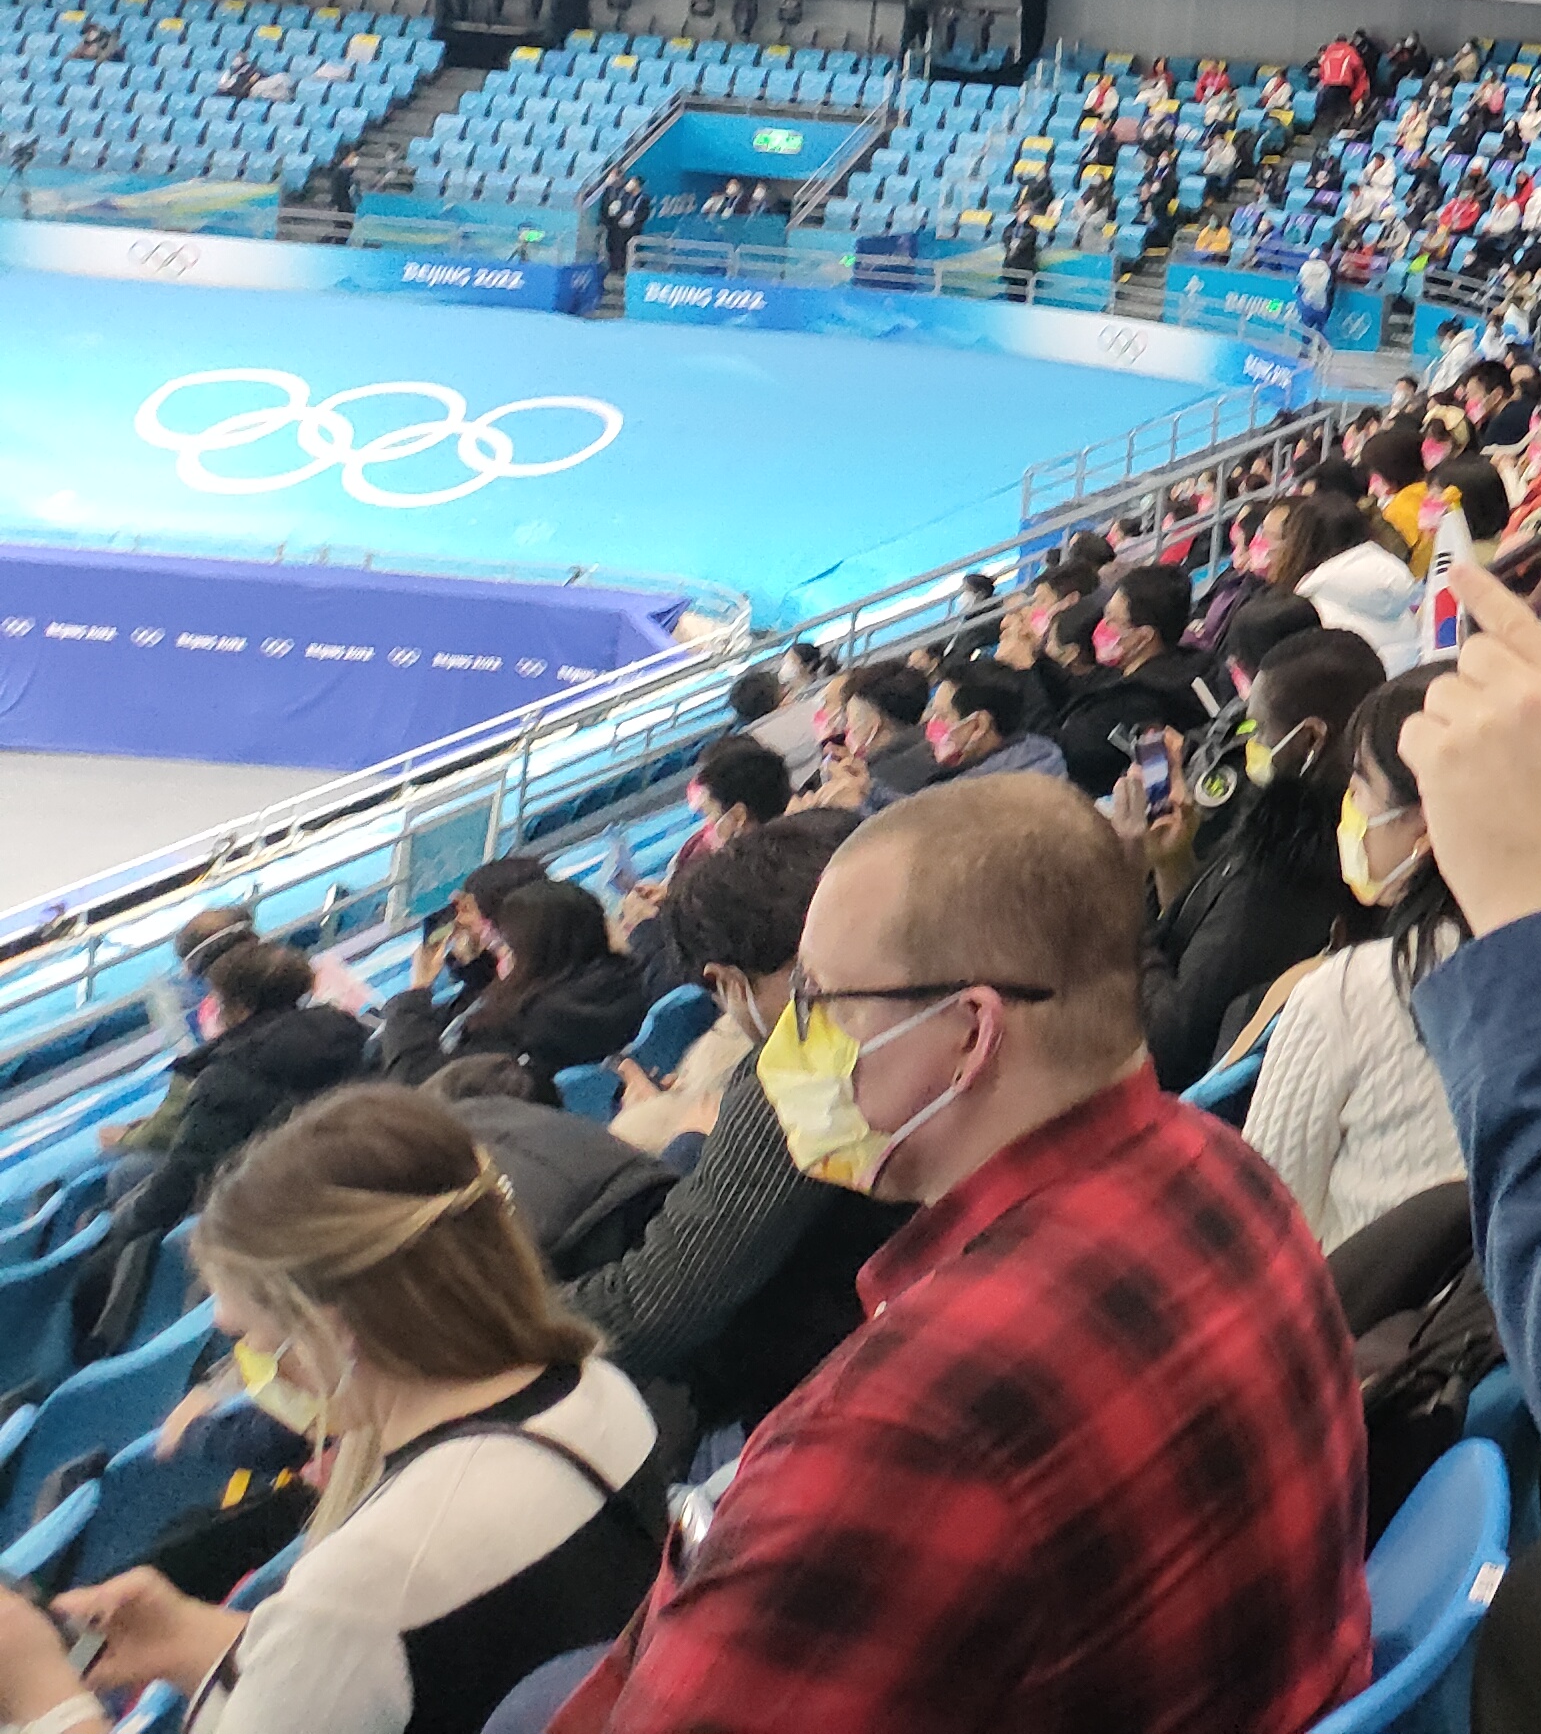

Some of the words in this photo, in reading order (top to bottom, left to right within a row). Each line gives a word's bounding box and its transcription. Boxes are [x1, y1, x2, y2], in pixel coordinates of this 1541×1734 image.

[401, 261, 471, 287] BEIJING
[644, 280, 713, 309] BEIJING
[713, 288, 768, 310] 2022
